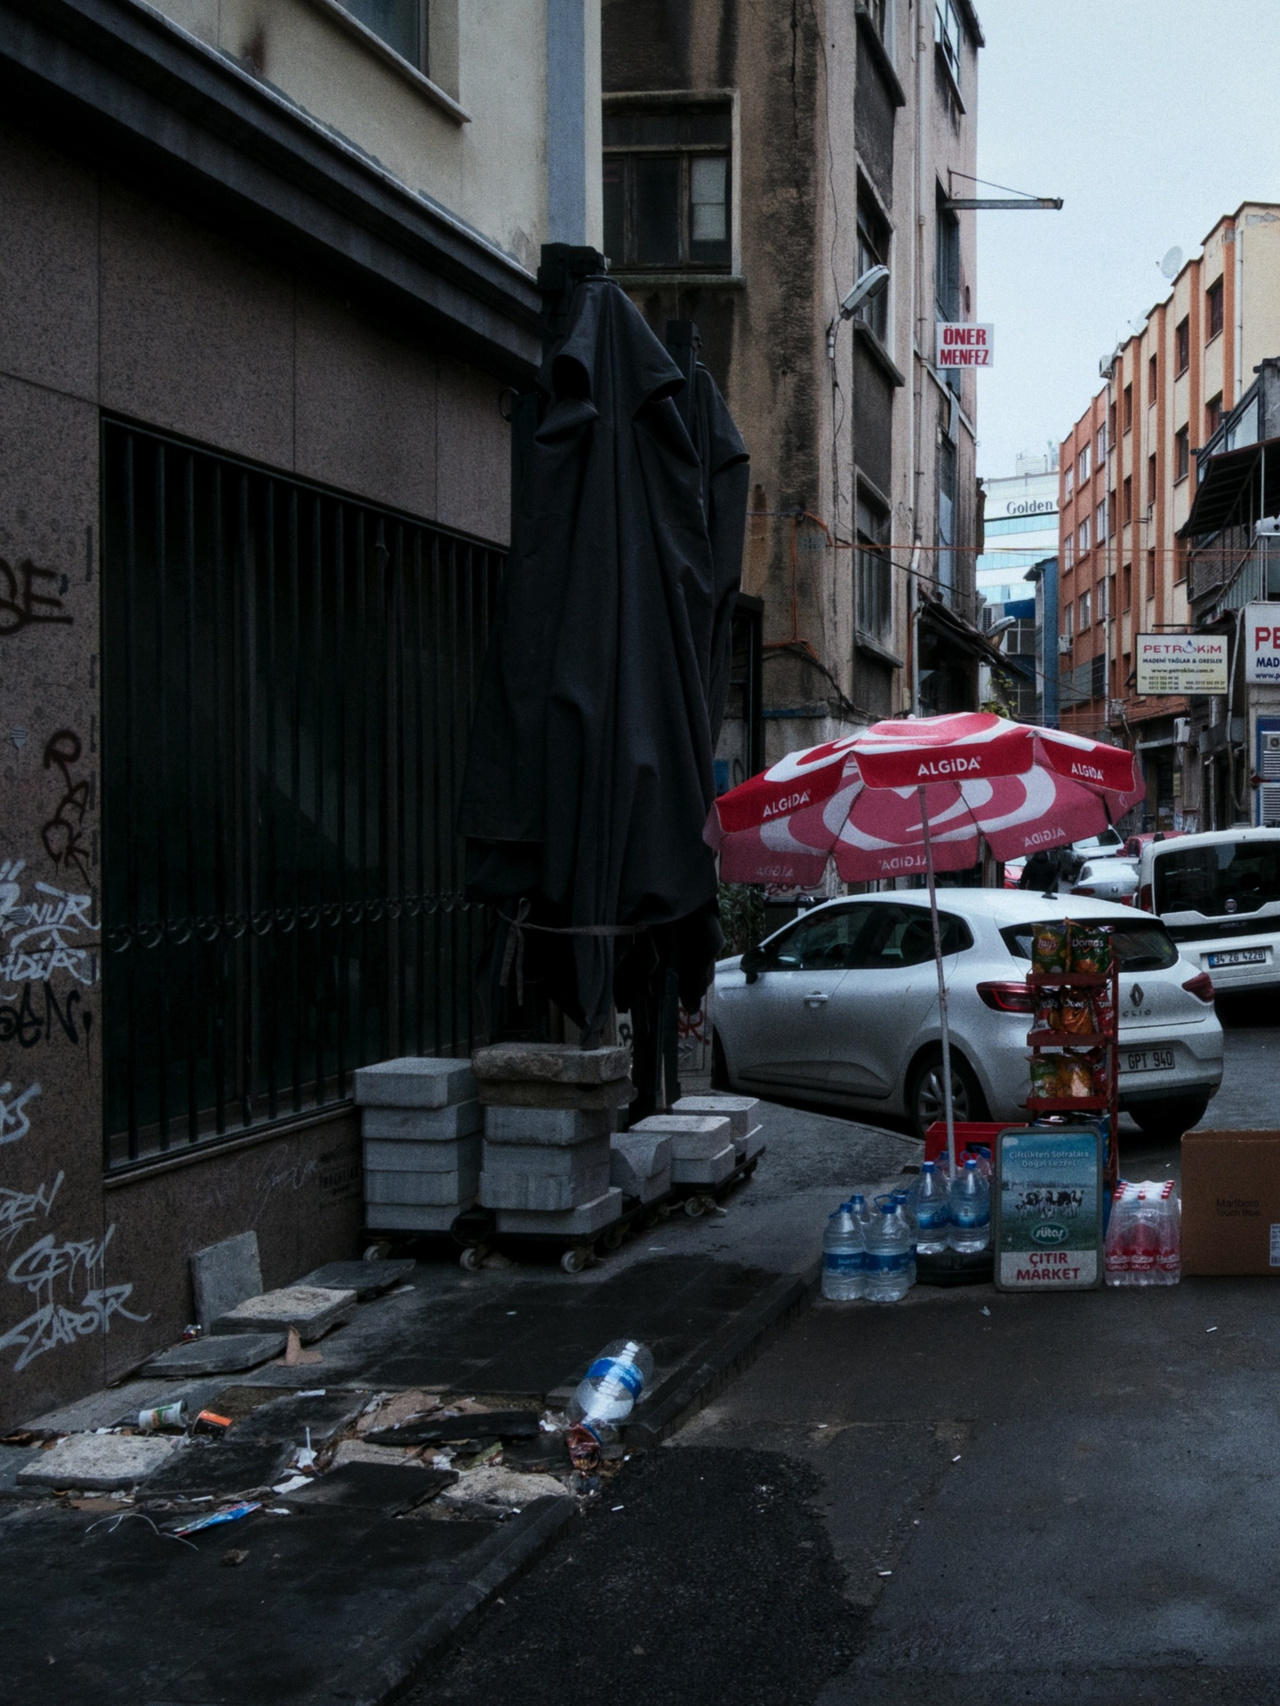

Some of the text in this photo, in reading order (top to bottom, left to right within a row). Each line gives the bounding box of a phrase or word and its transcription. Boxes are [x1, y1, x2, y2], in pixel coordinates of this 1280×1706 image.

[943, 325, 987, 346] ÖNER
[940, 349, 989, 365] MENFEZ
[1006, 499, 1053, 515] Golden
[1122, 1009, 1152, 1018] CLIO
[1128, 1051, 1174, 1069] GPT 940
[1216, 1198, 1260, 1207] Marlboro
[1216, 1208, 1261, 1217] Touch Blue
[1029, 1252, 1068, 1268] ÇITIR
[1016, 1268, 1081, 1281] MARKET
